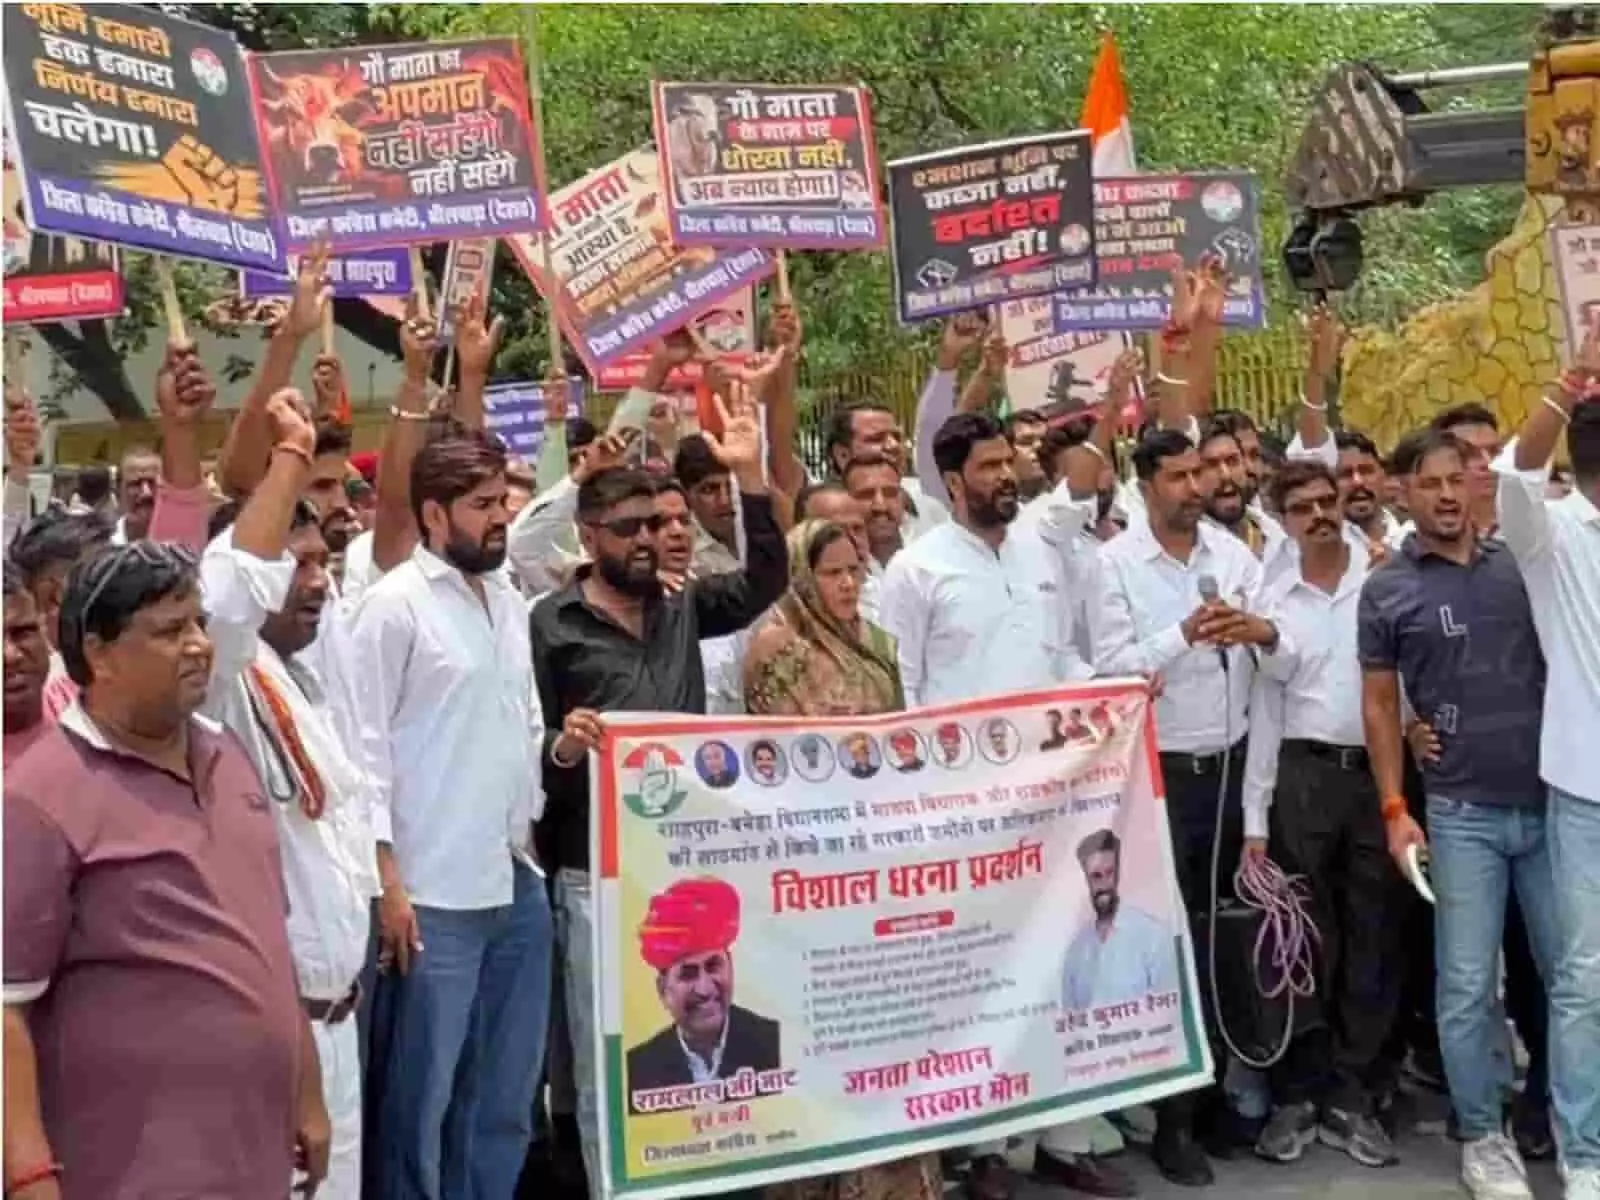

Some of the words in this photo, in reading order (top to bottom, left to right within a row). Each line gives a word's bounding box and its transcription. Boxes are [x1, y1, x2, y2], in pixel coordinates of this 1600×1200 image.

[92, 14, 171, 57] हमारी
[40, 31, 91, 66] हक
[93, 46, 176, 90] हमारा
[388, 50, 435, 81] माता
[32, 57, 119, 107] निर्णय
[121, 86, 198, 126] हमारा
[371, 73, 485, 120] अपमान
[725, 89, 760, 119] गौ
[764, 93, 838, 117] माता
[24, 101, 159, 157] चलेगा!
[409, 159, 456, 195] नहीं
[459, 151, 518, 189] सहेंगे
[721, 143, 792, 171] धोखा
[556, 168, 630, 226] माता
[771, 867, 880, 914] विशाल
[888, 857, 960, 900] धरना
[967, 838, 1044, 890] प्रदर्शन
[843, 1061, 911, 1094] जनता
[916, 1045, 993, 1080] परेशान
[905, 1084, 983, 1120] सरकार
[989, 1071, 1031, 1103] मौन
